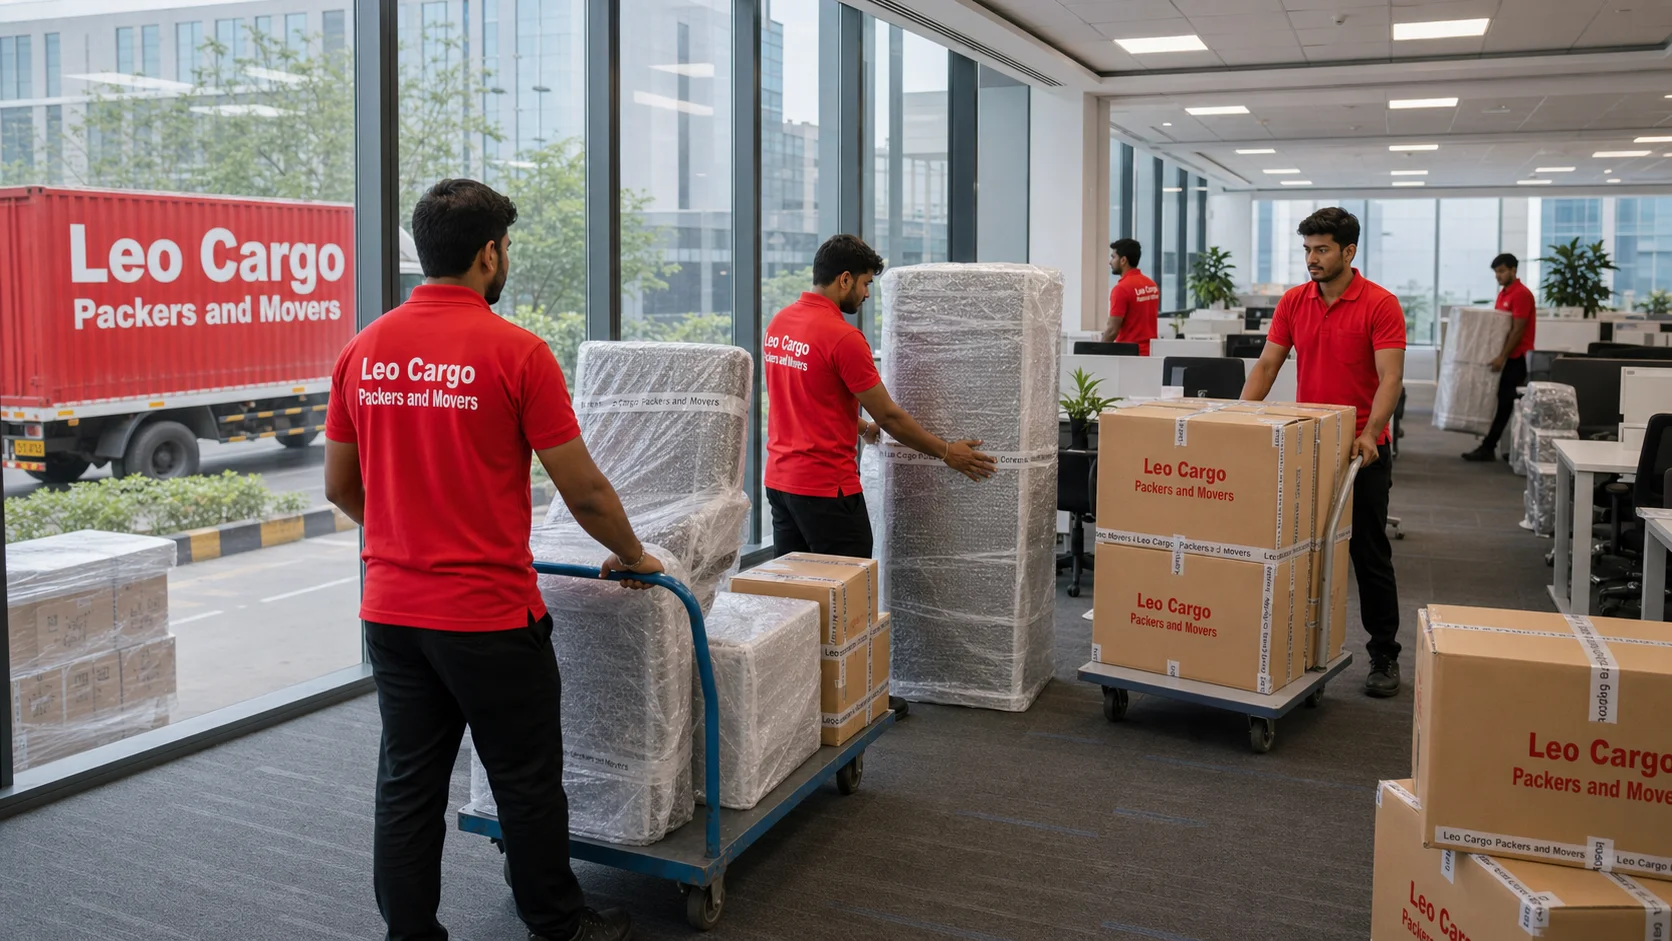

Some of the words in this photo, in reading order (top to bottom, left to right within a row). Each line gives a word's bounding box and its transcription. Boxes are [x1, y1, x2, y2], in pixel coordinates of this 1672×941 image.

[69, 223, 183, 283] Leo
[200, 227, 345, 295] Cargo
[74, 297, 197, 330] Packers
[205, 295, 252, 325] and
[259, 294, 341, 323] Movers
[764, 331, 779, 348] Leo
[781, 334, 810, 358] Cargo
[361, 357, 400, 380] Leo
[407, 357, 476, 389] Cargo
[358, 387, 404, 406] Packers
[407, 389, 429, 407] and
[432, 389, 478, 411] Movers
[641, 397, 670, 406] Packers
[672, 397, 687, 406] and
[689, 396, 720, 407] Movers
[1143, 457, 1172, 476] Leo
[1177, 460, 1227, 485] Cargo
[1134, 479, 1173, 497] Packers
[1176, 483, 1194, 498] and
[1197, 486, 1234, 502] Movers
[1137, 536, 1151, 545] Leo
[1152, 538, 1175, 548] Cargo
[1179, 541, 1210, 553] Packers
[1223, 547, 1251, 558] Movers
[1137, 592, 1163, 611] Leo
[1167, 597, 1211, 622] Cargo
[1130, 612, 1164, 630] Packers
[1166, 617, 1182, 632] and
[1184, 621, 1217, 638] Movers
[824, 647, 839, 657] Leo
[1529, 731, 1580, 762] Leo
[1590, 738, 1672, 778] Cargo
[1512, 766, 1582, 793] Packers
[1587, 779, 1621, 798] and
[1626, 780, 1672, 805] Move
[1443, 831, 1461, 842] Leo
[1463, 833, 1493, 847] Cargo
[1495, 838, 1532, 852] Packers
[1533, 844, 1551, 854] and
[1552, 846, 1586, 859] Movers
[1616, 855, 1636, 867] Leo
[1637, 859, 1667, 872] Cargo
[1409, 879, 1435, 922] Leo
[1439, 907, 1471, 941] Car
